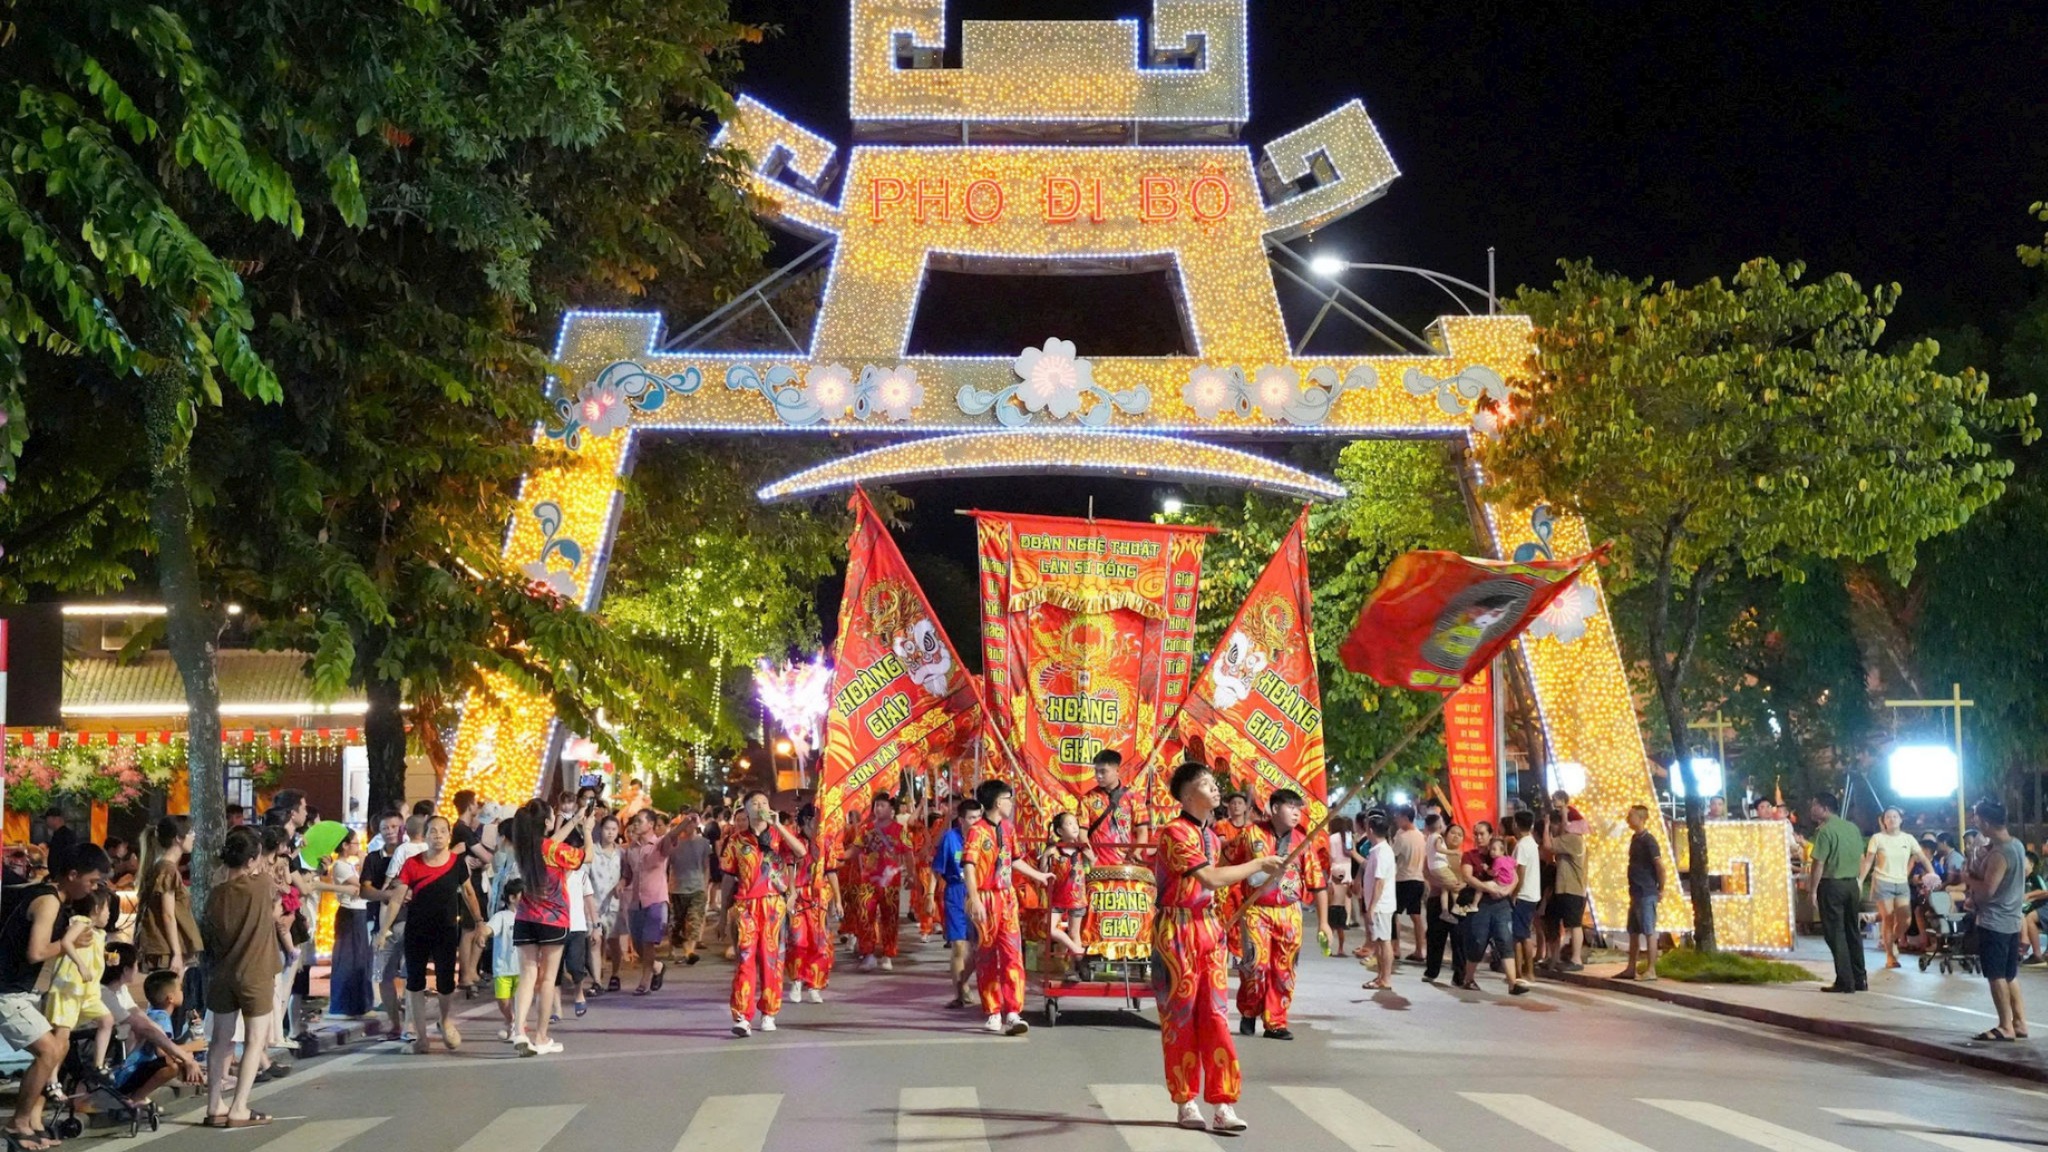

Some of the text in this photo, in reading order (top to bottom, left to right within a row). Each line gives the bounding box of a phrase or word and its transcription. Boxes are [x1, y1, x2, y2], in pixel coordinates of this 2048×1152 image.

[1046, 177, 1103, 221] ĐI
[1142, 161, 1232, 233] BỘ
[1020, 533, 1160, 558] ĐOÀN NGHỆ THUẬT
[1040, 557, 1069, 573] LÂN
[835, 652, 905, 717] HOÀNG
[1256, 669, 1322, 734] HOÀNG
[865, 691, 912, 738] GIÁP
[1046, 691, 1118, 725] HOÀNG
[1245, 709, 1290, 753] GIÁP
[847, 741, 900, 789] SƠN TÂY
[1060, 733, 1103, 764] GIÁP
[1255, 757, 1281, 786] SƠN
[1092, 888, 1148, 912] HOÀNG
[1101, 913, 1140, 938] GIÁP
